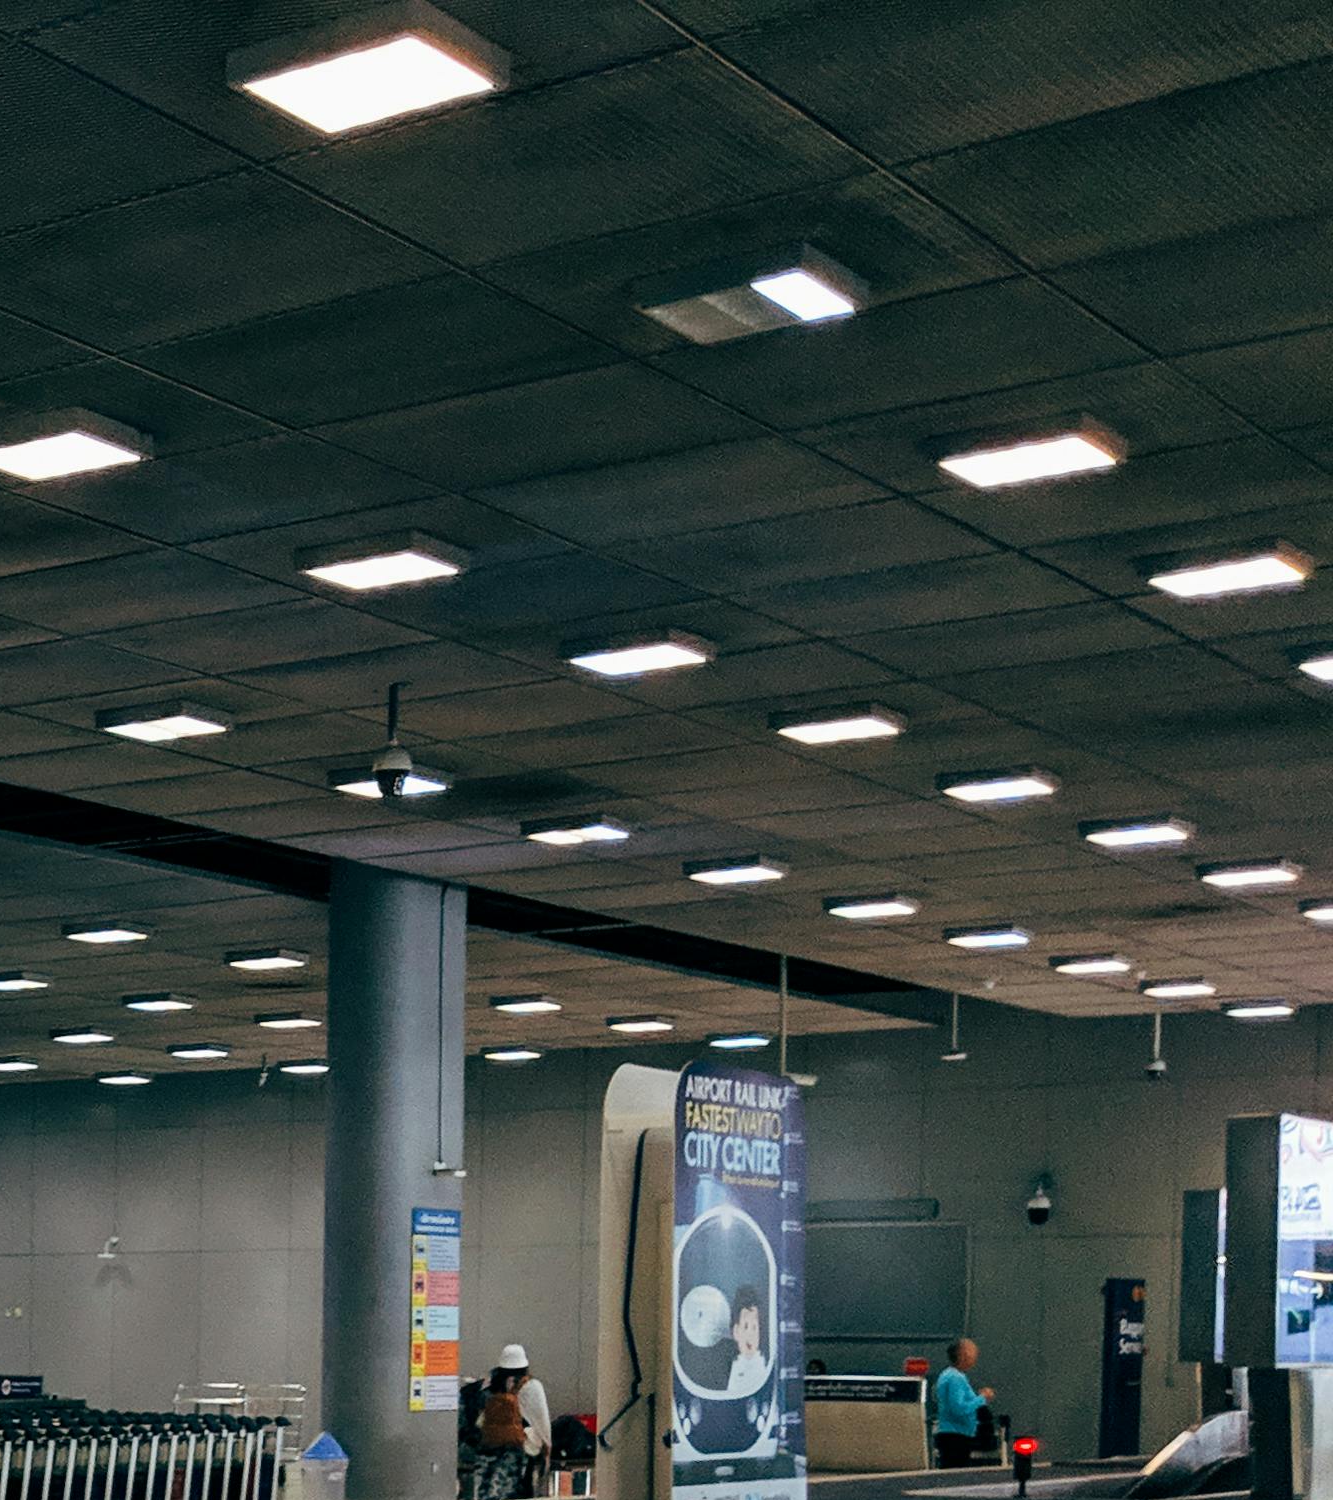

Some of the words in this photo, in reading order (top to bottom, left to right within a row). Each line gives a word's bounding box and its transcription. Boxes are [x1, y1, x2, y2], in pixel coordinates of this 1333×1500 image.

[685, 1074, 733, 1102] AIRPORT
[685, 1100, 738, 1133] FASTEST
[684, 1131, 721, 1169] CITY
[722, 1136, 782, 1175] CENTER
